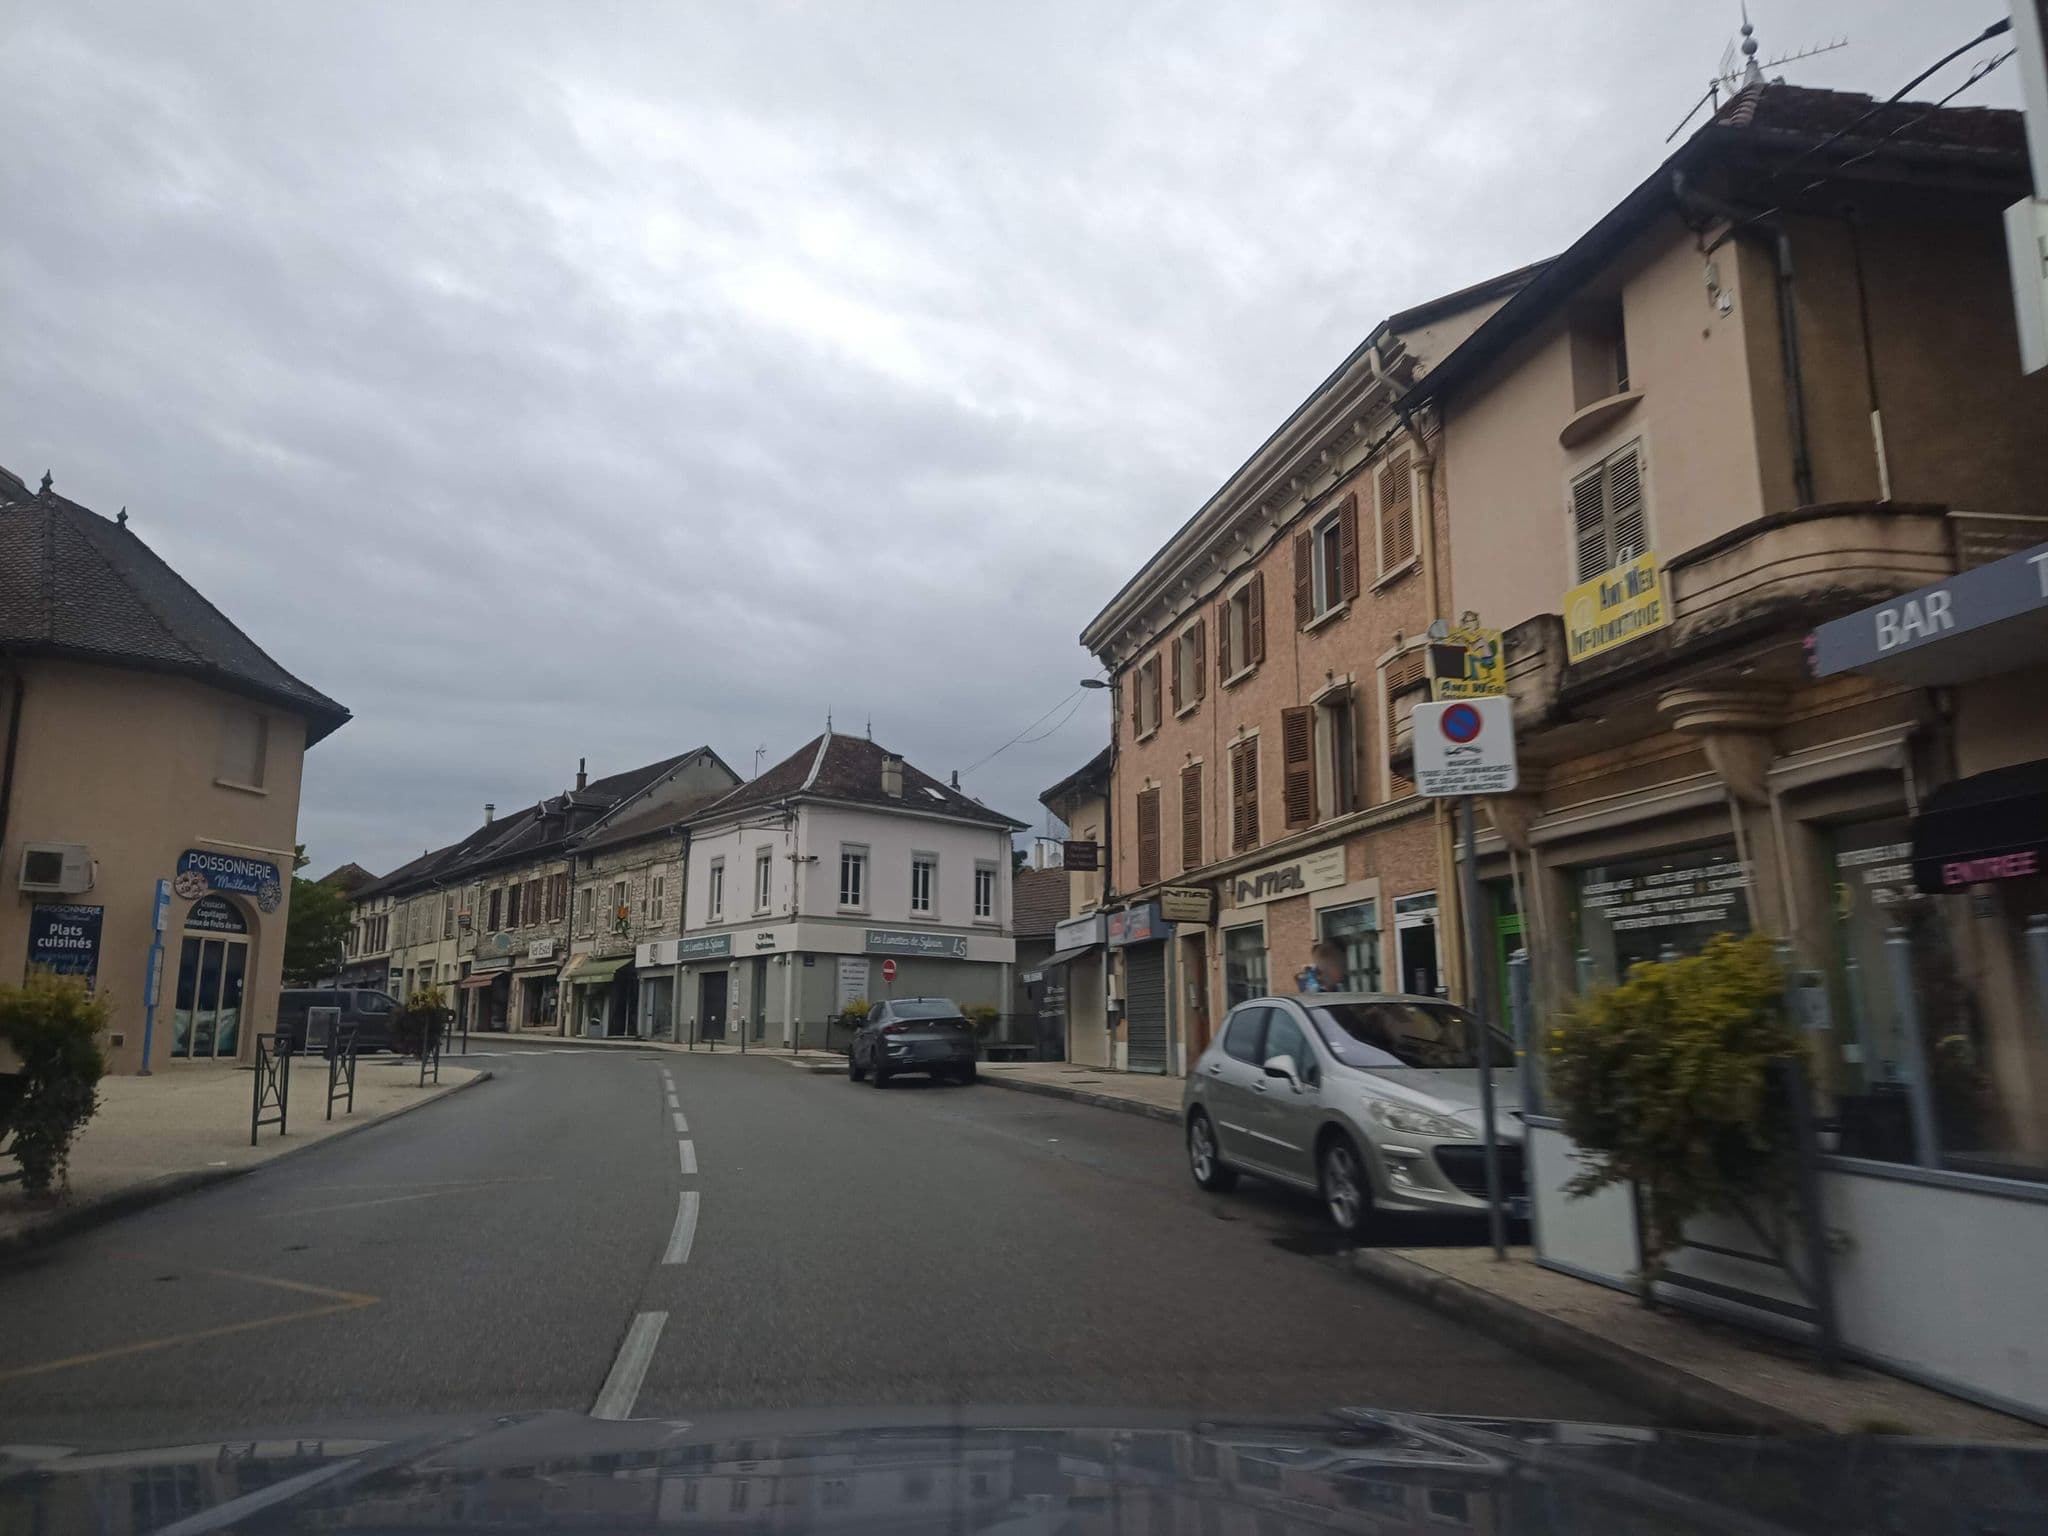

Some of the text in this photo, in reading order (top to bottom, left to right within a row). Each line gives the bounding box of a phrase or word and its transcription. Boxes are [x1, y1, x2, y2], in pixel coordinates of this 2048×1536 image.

[1874, 589, 1955, 652] BAR
[188, 853, 272, 879] POISSONNERIE
[49, 923, 82, 936] Plats
[37, 936, 92, 949] cuisinés
